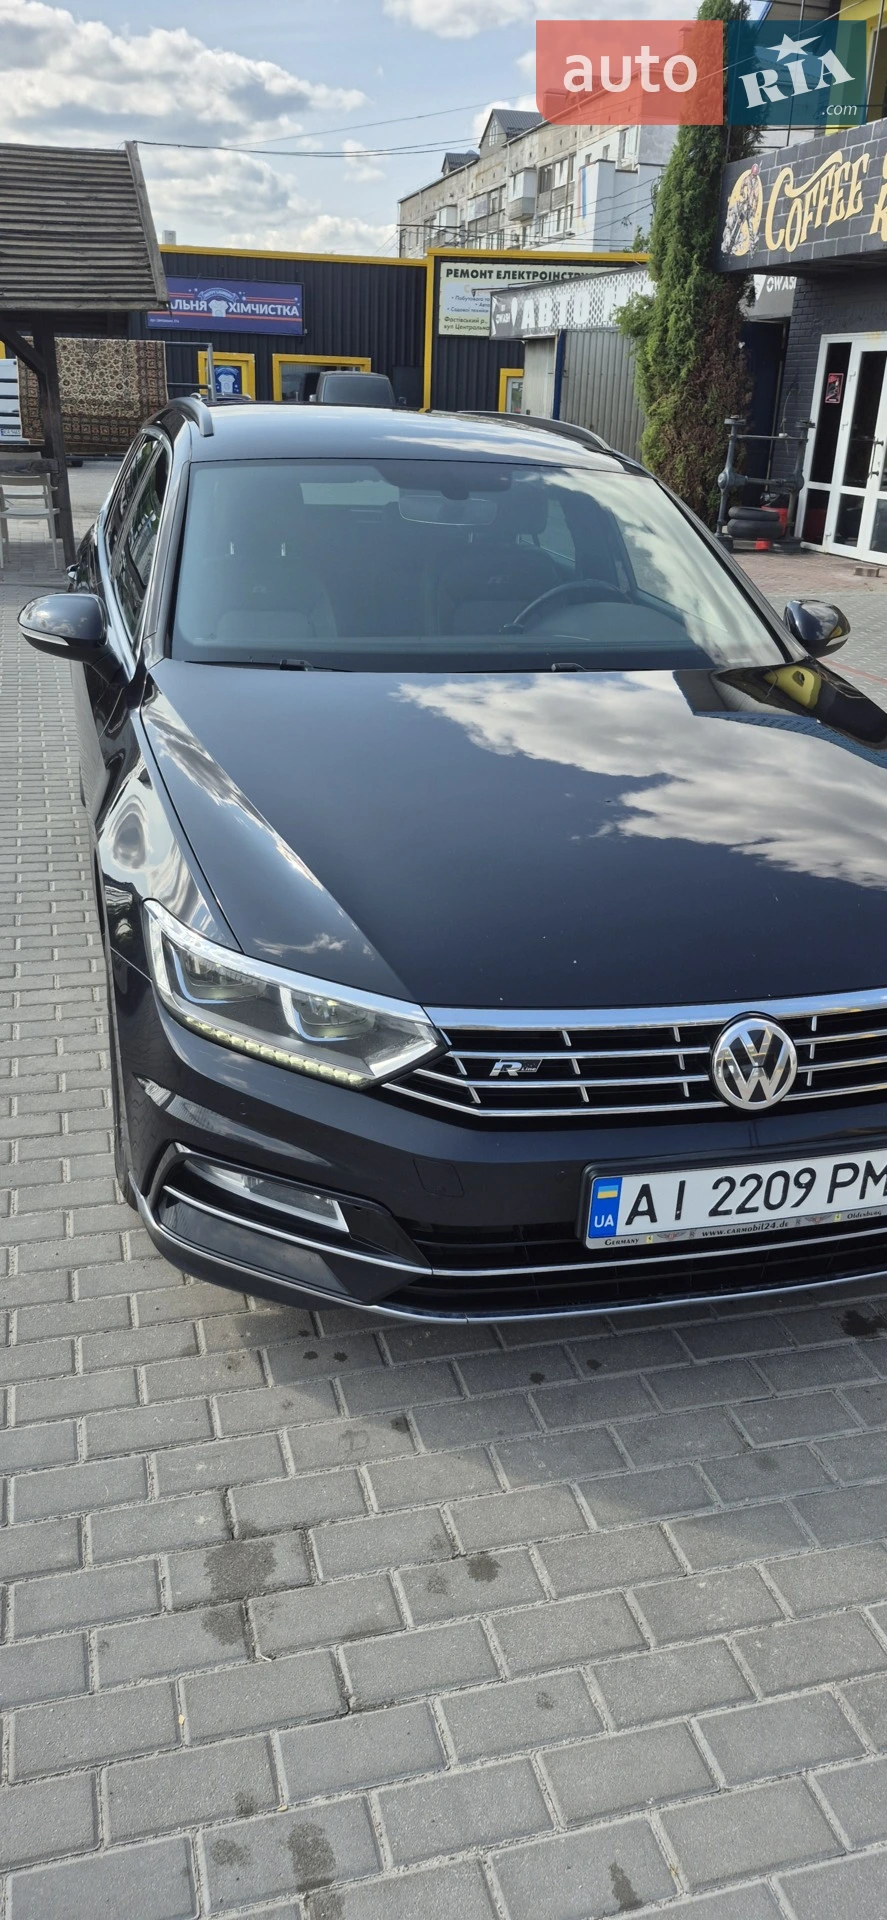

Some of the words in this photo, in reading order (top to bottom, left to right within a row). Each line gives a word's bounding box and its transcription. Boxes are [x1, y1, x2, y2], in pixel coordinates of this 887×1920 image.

[446, 269, 493, 279] РЕМОНТ
[228, 302, 299, 316] ХІМЧИСТКА
[521, 291, 590, 329] АВТО
[708, 1167, 817, 1217] 2209
[827, 1160, 887, 1204] PM
[594, 1214, 614, 1228] UA
